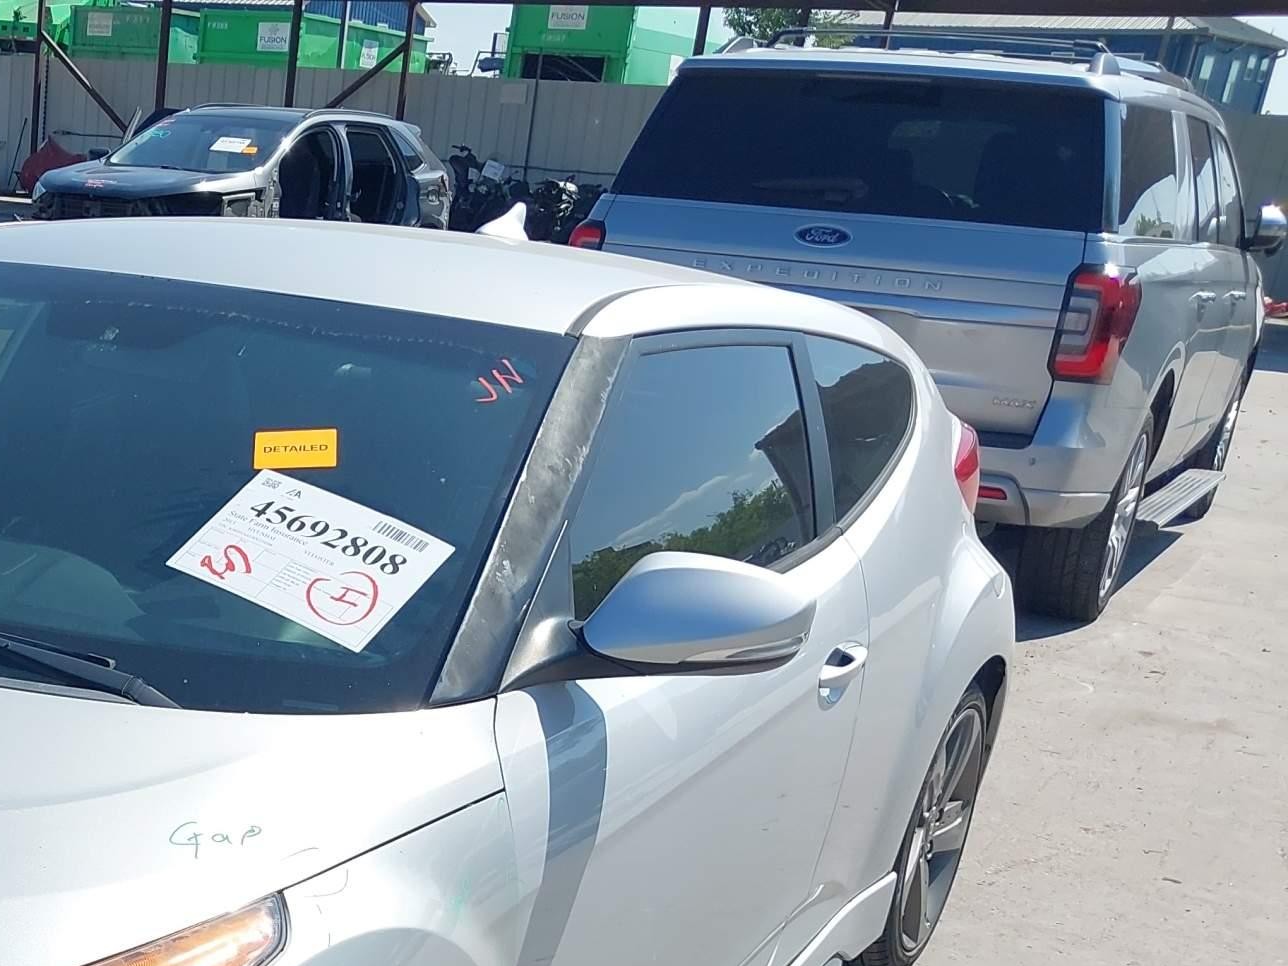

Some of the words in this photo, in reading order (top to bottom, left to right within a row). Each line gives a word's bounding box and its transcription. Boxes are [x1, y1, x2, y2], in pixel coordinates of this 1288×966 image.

[551, 12, 585, 21] FUSION
[259, 36, 288, 44] FUSION
[805, 228, 840, 243] Ford
[691, 257, 944, 291] EXPEDITION
[263, 444, 329, 454] DETAILED
[230, 510, 249, 523] State
[249, 518, 270, 531] Farm
[270, 526, 309, 547] Insurance
[249, 500, 408, 577] 45692808
[168, 821, 262, 859] Gap
